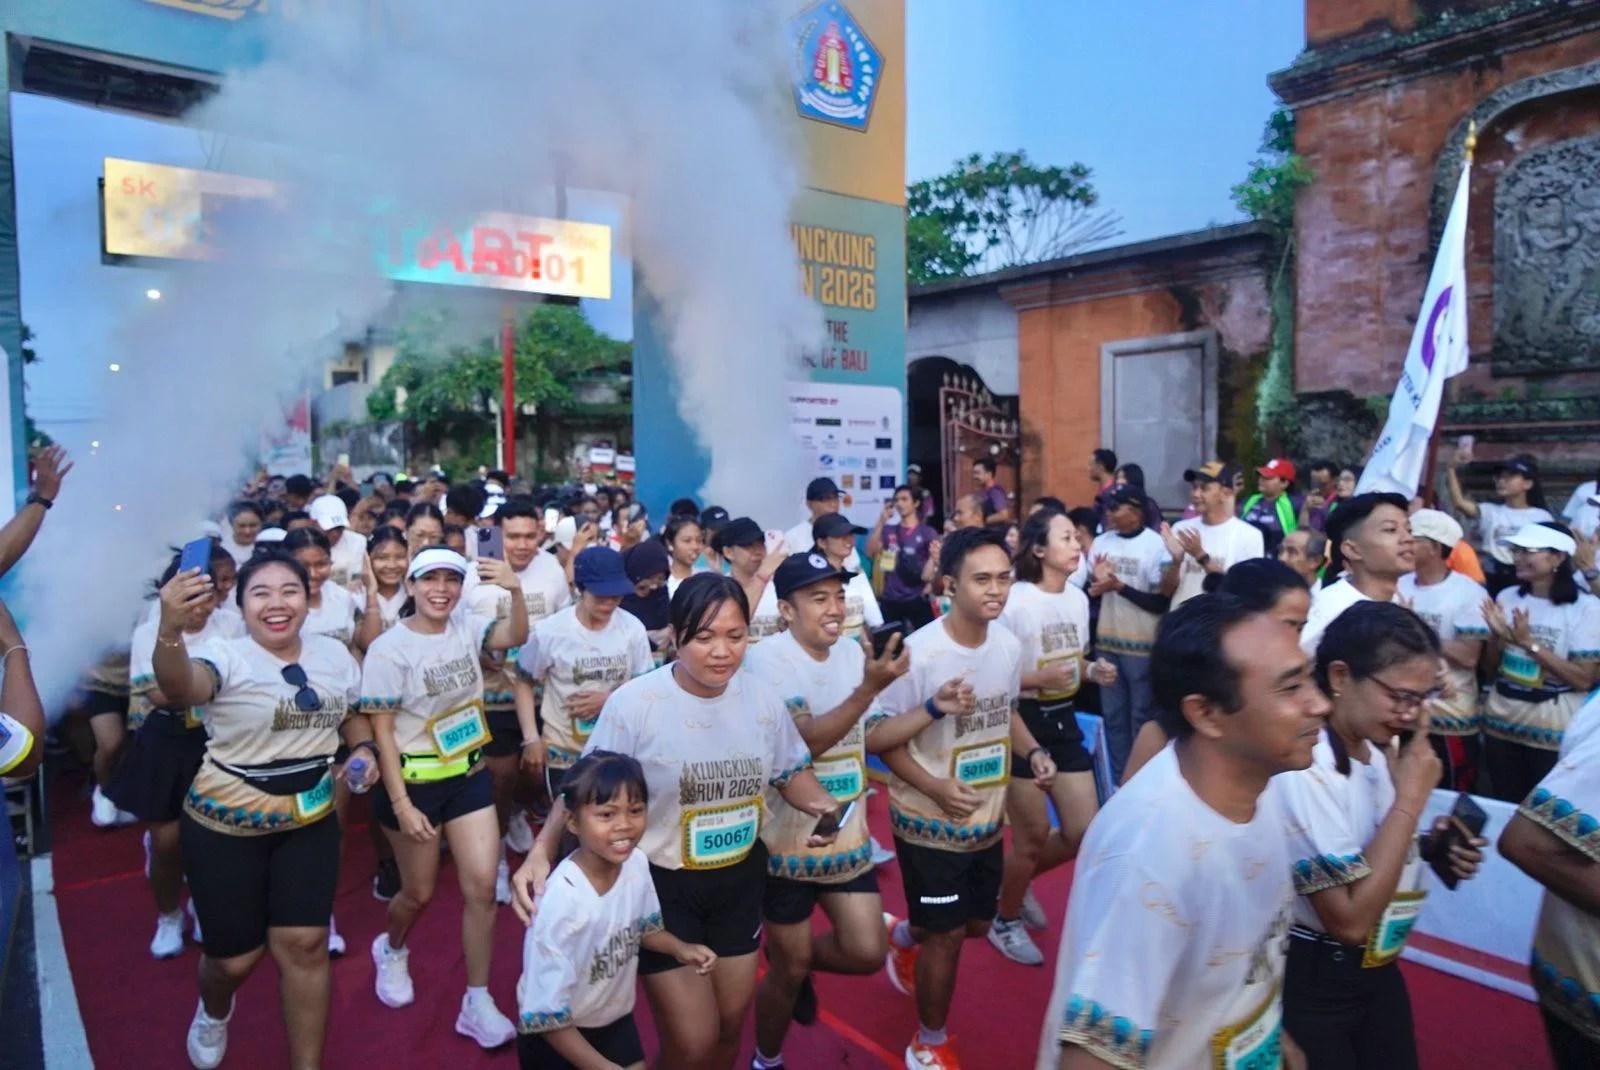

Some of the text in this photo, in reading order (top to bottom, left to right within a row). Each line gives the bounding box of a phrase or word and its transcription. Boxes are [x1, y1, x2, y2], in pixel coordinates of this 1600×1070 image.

[122, 176, 157, 200] 5K
[820, 266, 876, 311] 2026
[825, 319, 848, 343] THE
[821, 346, 837, 369] OF
[841, 348, 868, 371] BALI
[444, 721, 478, 746] 50723
[963, 760, 999, 778] 50100
[697, 781, 725, 802] RUN
[703, 825, 752, 850] 50067
